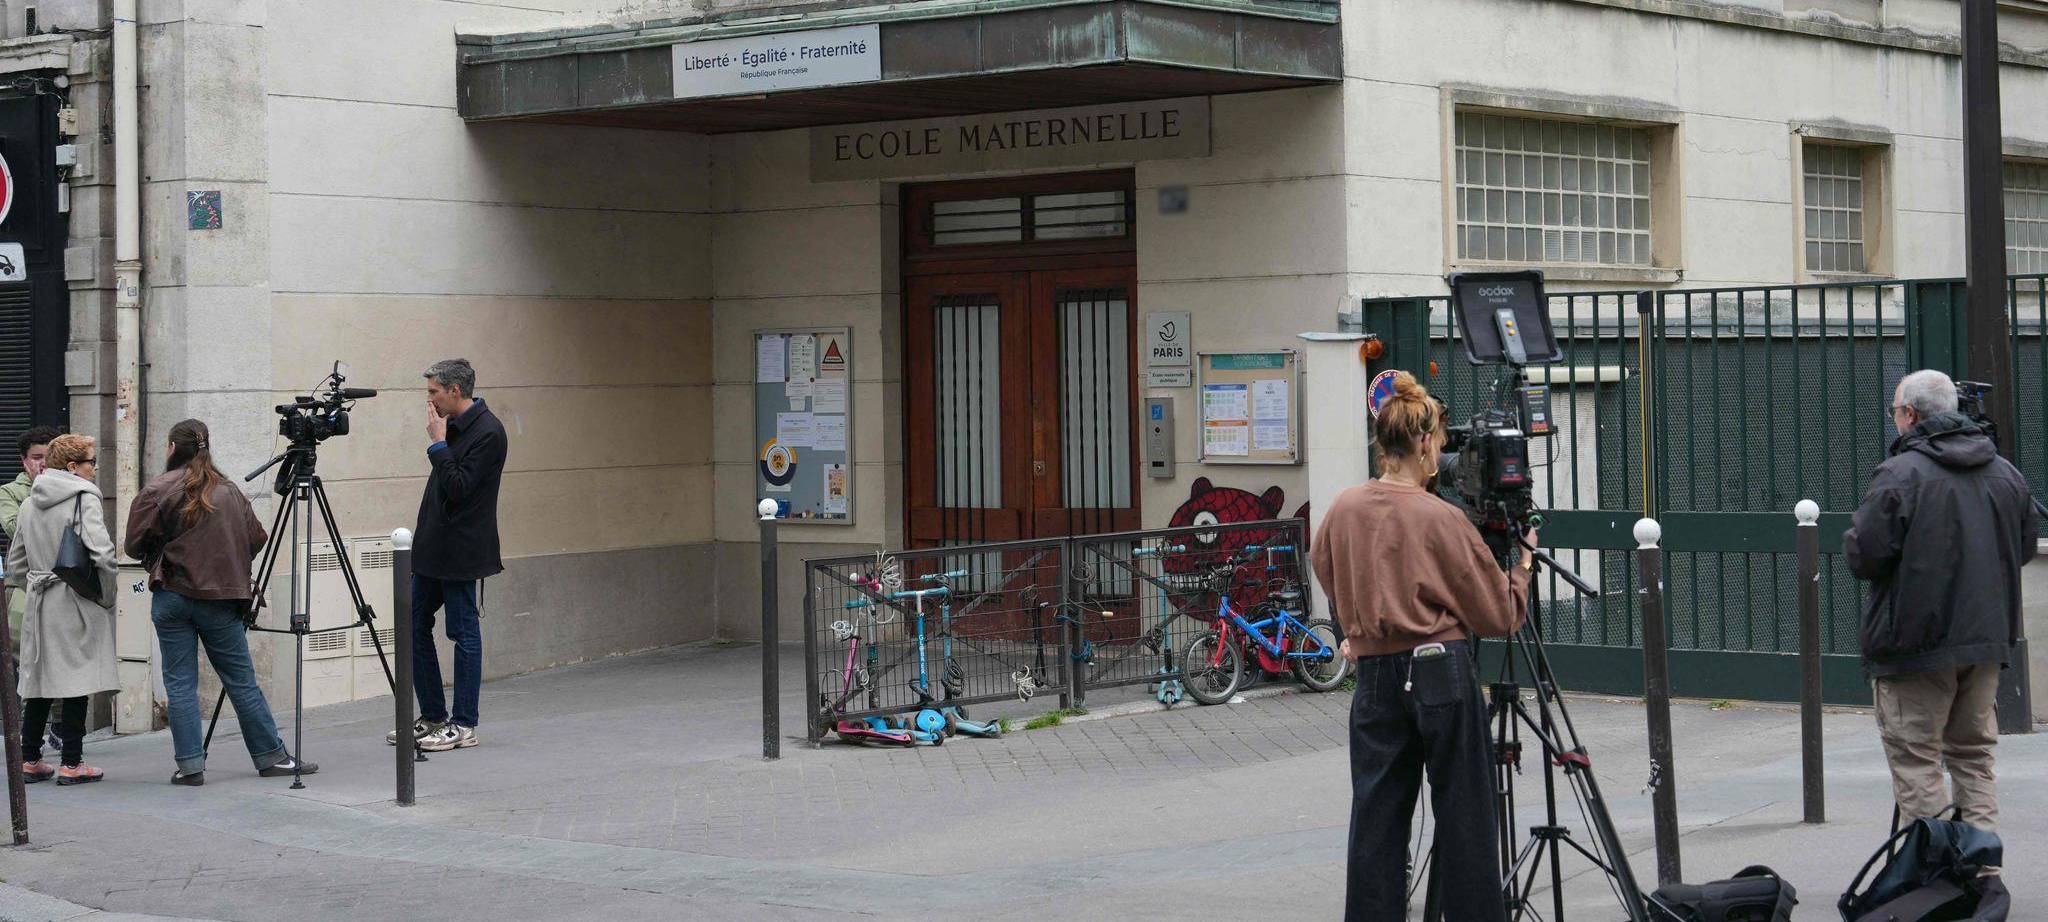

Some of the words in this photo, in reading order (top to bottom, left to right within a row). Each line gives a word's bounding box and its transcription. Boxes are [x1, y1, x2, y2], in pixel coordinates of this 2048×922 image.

[685, 53, 730, 71] Liberté
[742, 48, 788, 67] Égalité
[800, 40, 867, 60] Fraternité
[740, 70, 777, 79] République
[777, 67, 809, 77] Française
[834, 128, 942, 161] ECOLE
[959, 110, 1182, 153] MATERNELLE
[1153, 347, 1184, 358] PARIS
